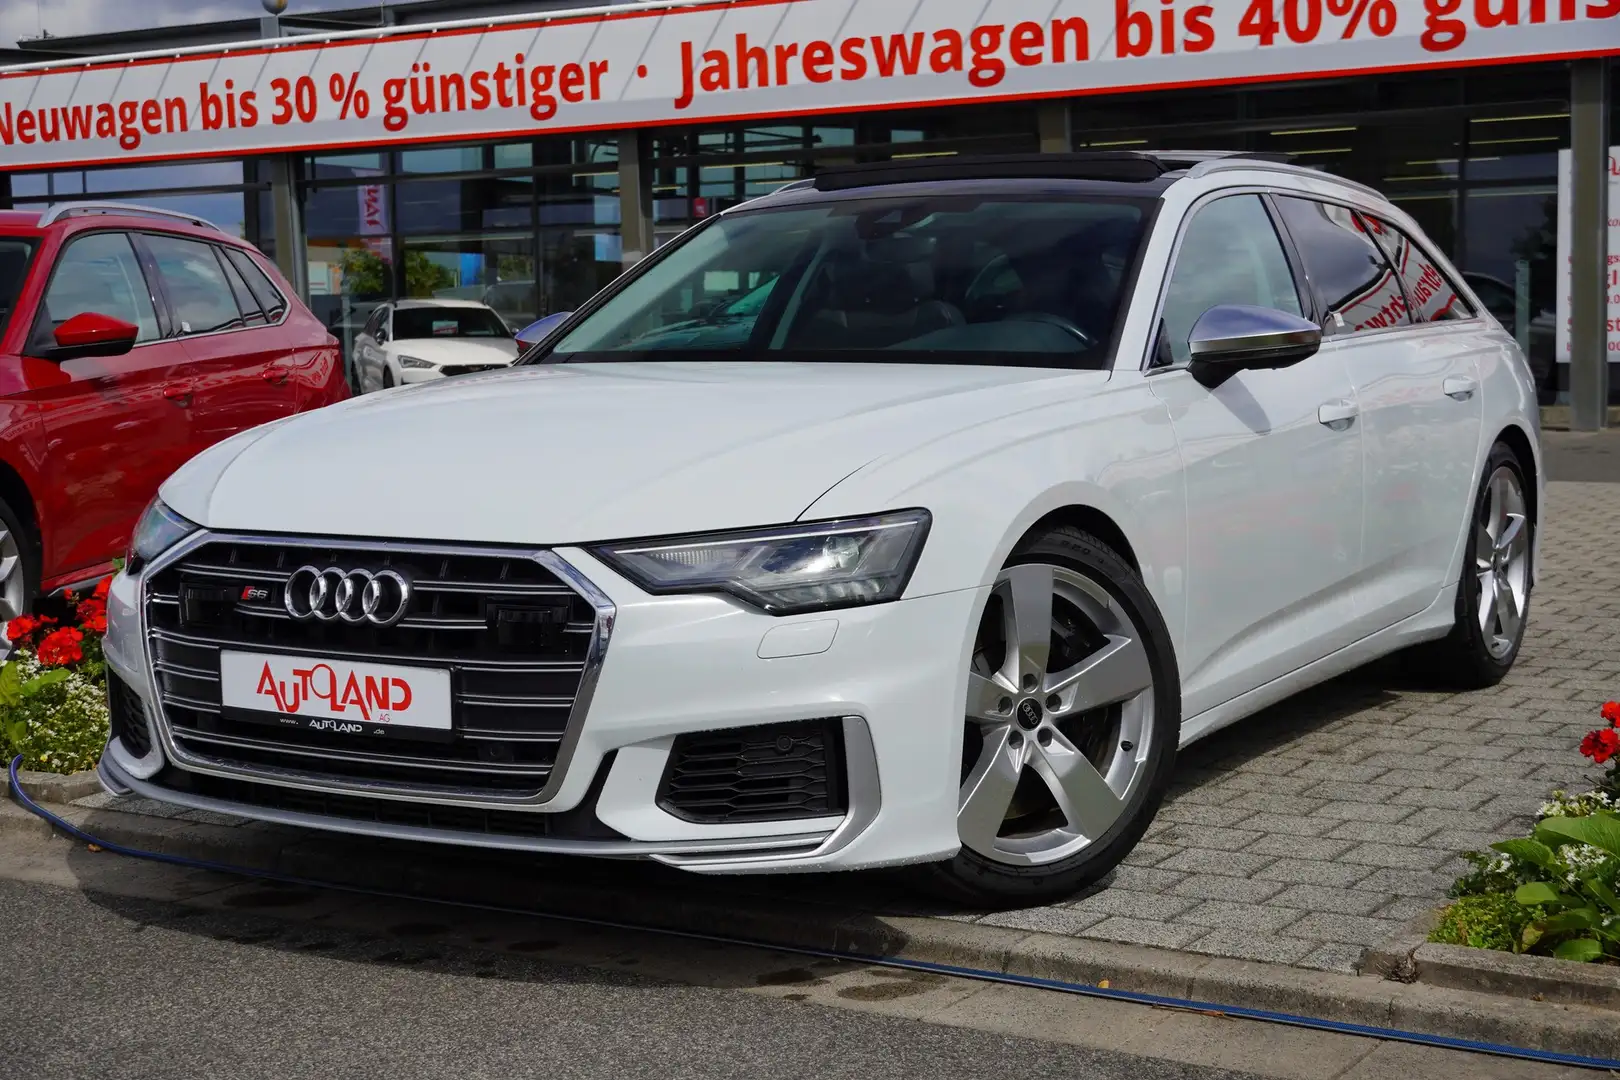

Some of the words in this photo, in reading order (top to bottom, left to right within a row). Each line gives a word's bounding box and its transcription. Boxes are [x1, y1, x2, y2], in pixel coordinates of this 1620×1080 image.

[0, 96, 188, 151] Neuwagen
[199, 78, 259, 130] bis
[270, 75, 318, 125] 30
[329, 71, 370, 120] %
[383, 53, 609, 132] günstiger
[674, 16, 1089, 110] Jahreswagen
[1115, 0, 1216, 58] bis
[1238, 0, 1398, 46] 40%
[243, 587, 268, 599] S6
[379, 713, 391, 723] AG
